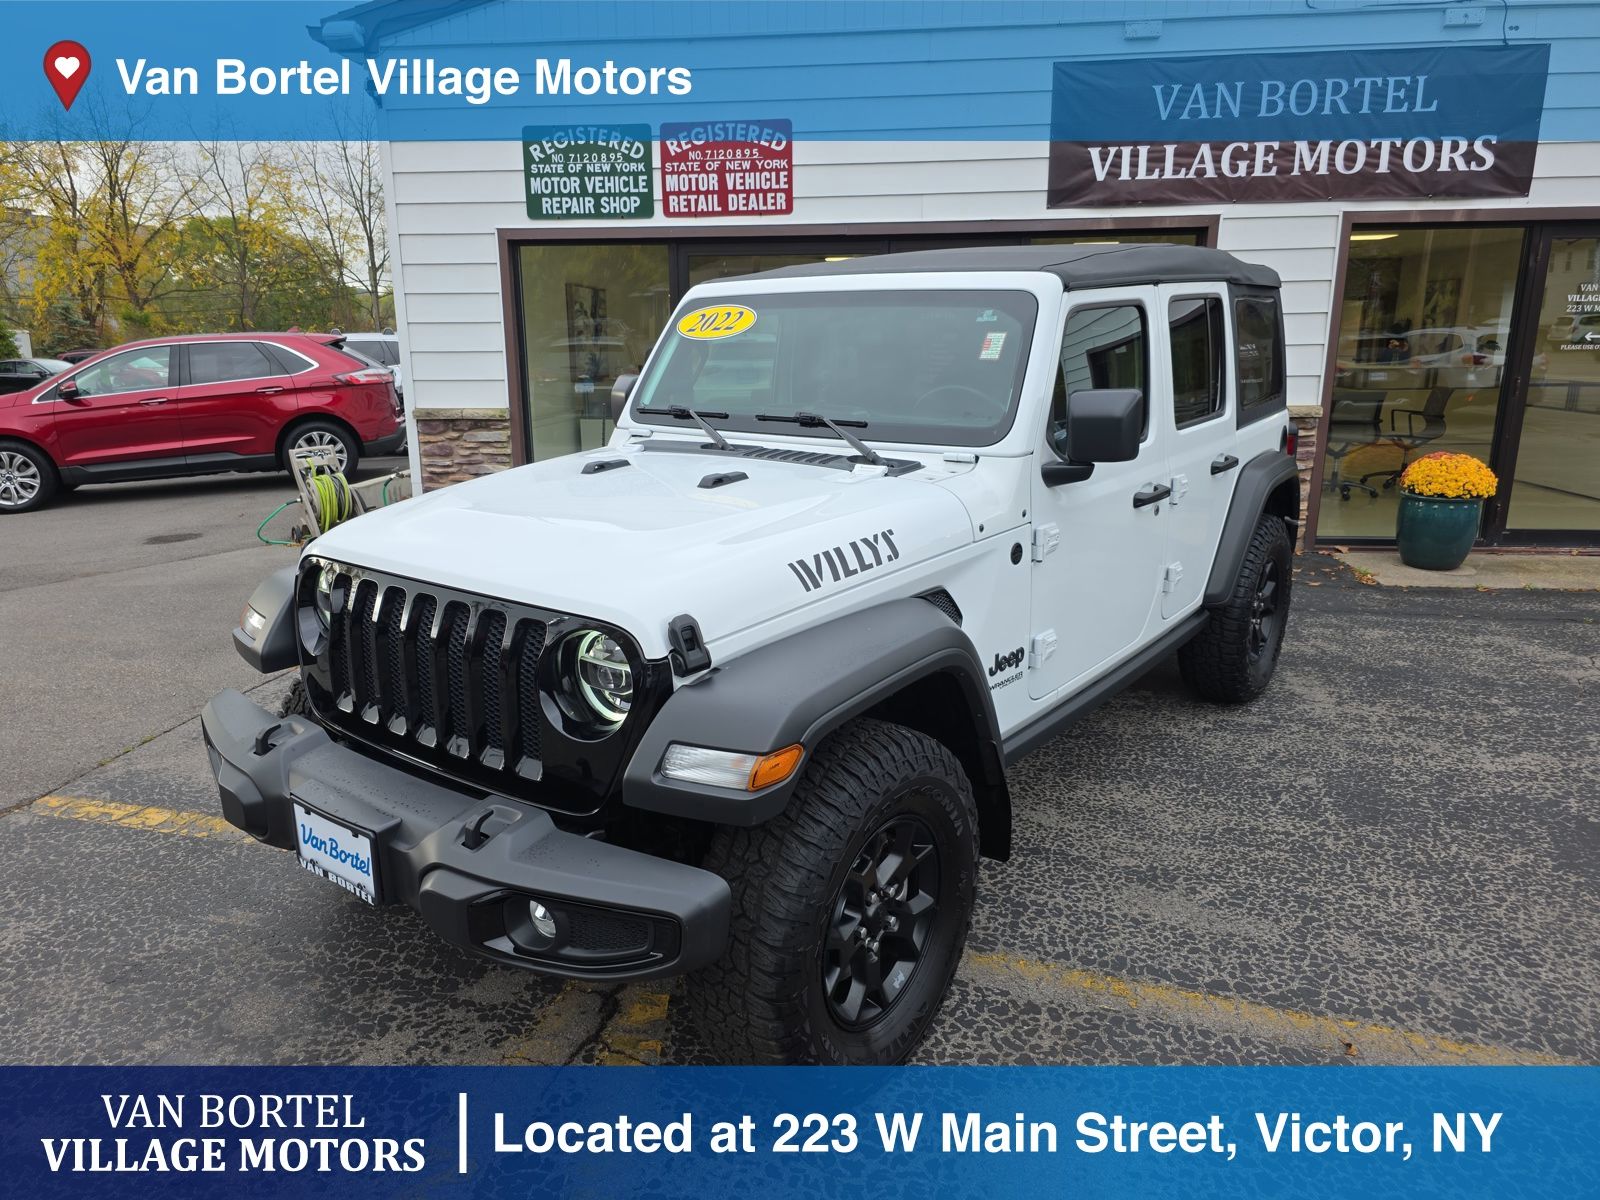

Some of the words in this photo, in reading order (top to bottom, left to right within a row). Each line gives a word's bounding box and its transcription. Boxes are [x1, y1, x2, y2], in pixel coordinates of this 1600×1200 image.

[1152, 82, 1244, 121] VAN
[1257, 75, 1438, 117] BORTEL
[528, 126, 645, 162] REGISTERED
[665, 123, 787, 156] REGISTERED
[568, 152, 624, 163] 7120895
[705, 149, 759, 159] 7120895
[1088, 142, 1279, 182] VILLAGE
[1290, 135, 1497, 176] MOTORS
[531, 164, 564, 174] STATE
[568, 163, 583, 173] OF
[587, 163, 611, 173] NEW
[615, 162, 646, 172] YORK
[665, 162, 700, 172] STATE
[706, 161, 721, 171] OF
[726, 160, 751, 170] NEW
[756, 159, 788, 169] YORK
[530, 177, 581, 194] MOTOR
[584, 175, 648, 193] VEHICLE
[665, 174, 719, 192] MOTOR
[725, 171, 788, 190] VEHICLE
[542, 197, 595, 214] REPAIR
[600, 196, 640, 213] SHOP
[669, 194, 722, 213] RETAIL
[728, 192, 787, 212] DEALER
[1581, 283, 1598, 291] VAN
[1566, 304, 1581, 312] 223
[686, 311, 744, 333] 2022
[787, 528, 899, 592] WILLYS
[989, 646, 1025, 677] Jeep
